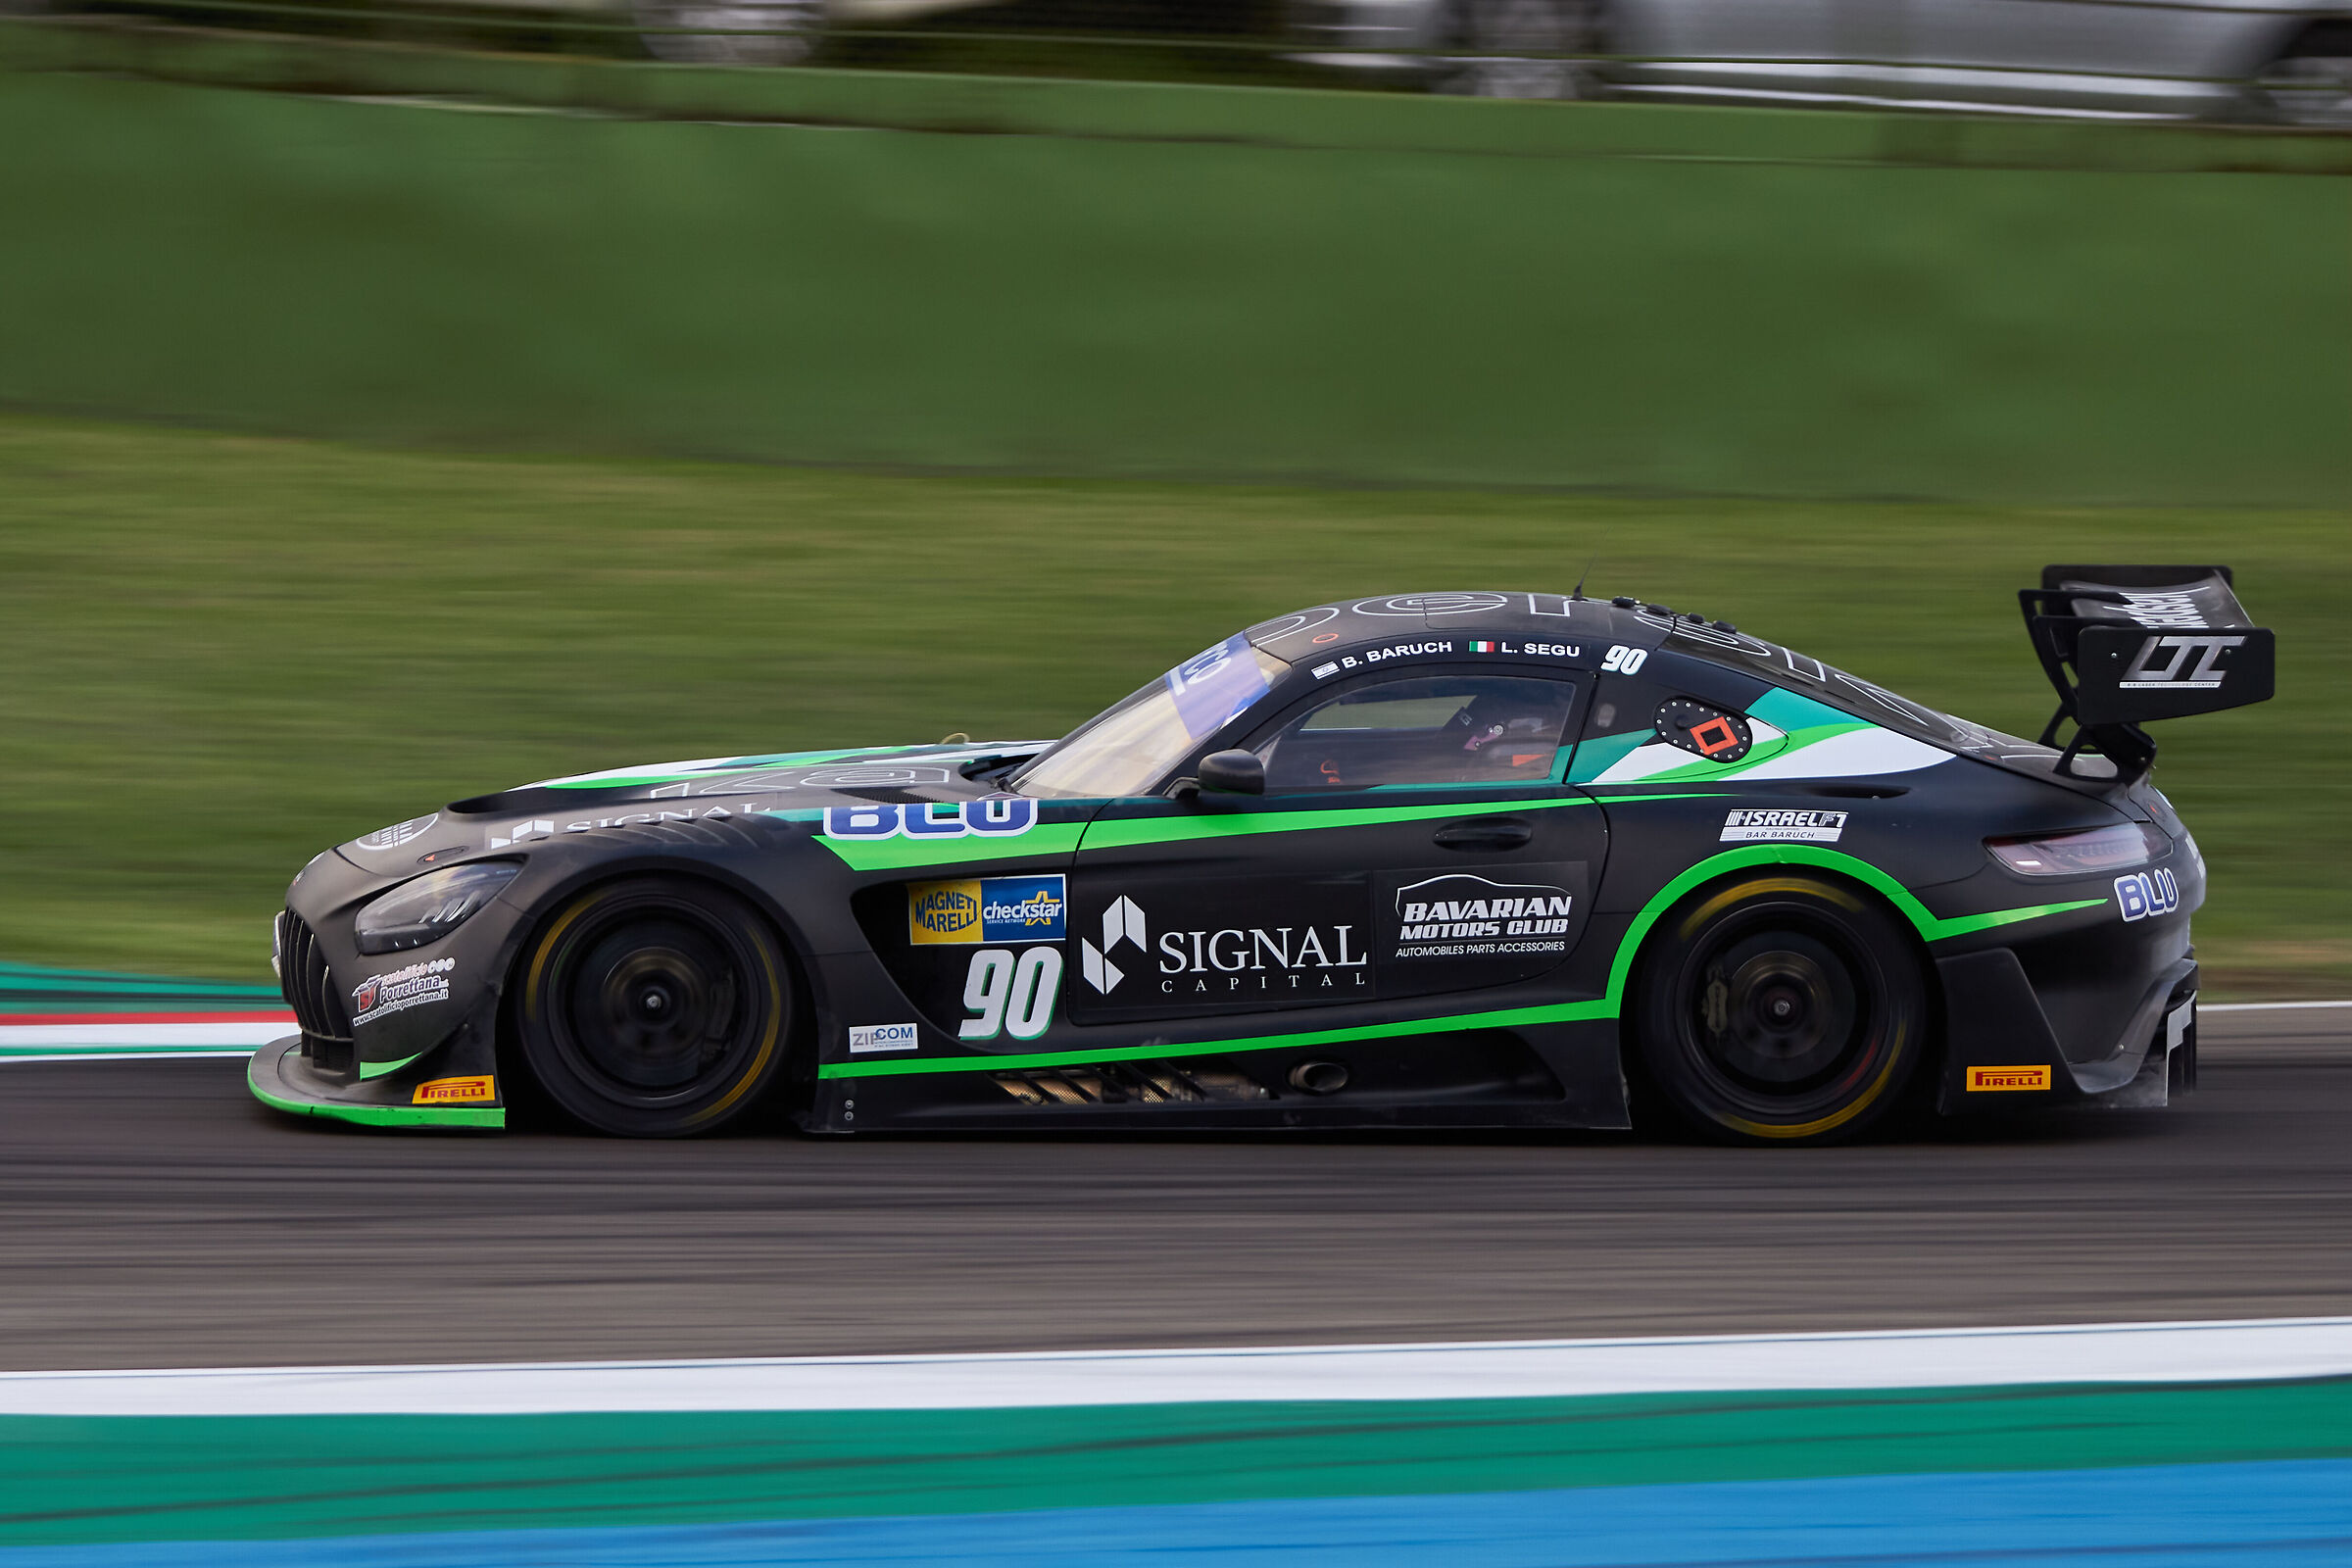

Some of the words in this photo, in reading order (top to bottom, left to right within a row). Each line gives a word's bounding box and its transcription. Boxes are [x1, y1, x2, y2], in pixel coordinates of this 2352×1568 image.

[1341, 656, 1363, 669] B.
[1366, 641, 1452, 662] BARUCH
[1500, 641, 1518, 654] L.
[1524, 642, 1581, 658] SEGU
[1600, 644, 1648, 676] 90
[2114, 867, 2179, 922] BLU
[983, 900, 1062, 920] checkstar
[1403, 896, 1572, 922] BAVARIAN
[1399, 920, 1501, 941] MOTORS
[1505, 918, 1569, 936] CLUB
[1158, 925, 1367, 974] SIGNAL
[1395, 945, 1465, 957] AUTOMOBILES
[1466, 943, 1495, 954] PARTS
[1496, 941, 1565, 953] ACCESSORIES
[379, 975, 441, 1004] Porrettana
[957, 946, 1064, 1041] 90
[1161, 972, 1366, 993] CAPITAL
[420, 1081, 486, 1099] PIRELLI
[1975, 1070, 2043, 1087] PIRELLI
